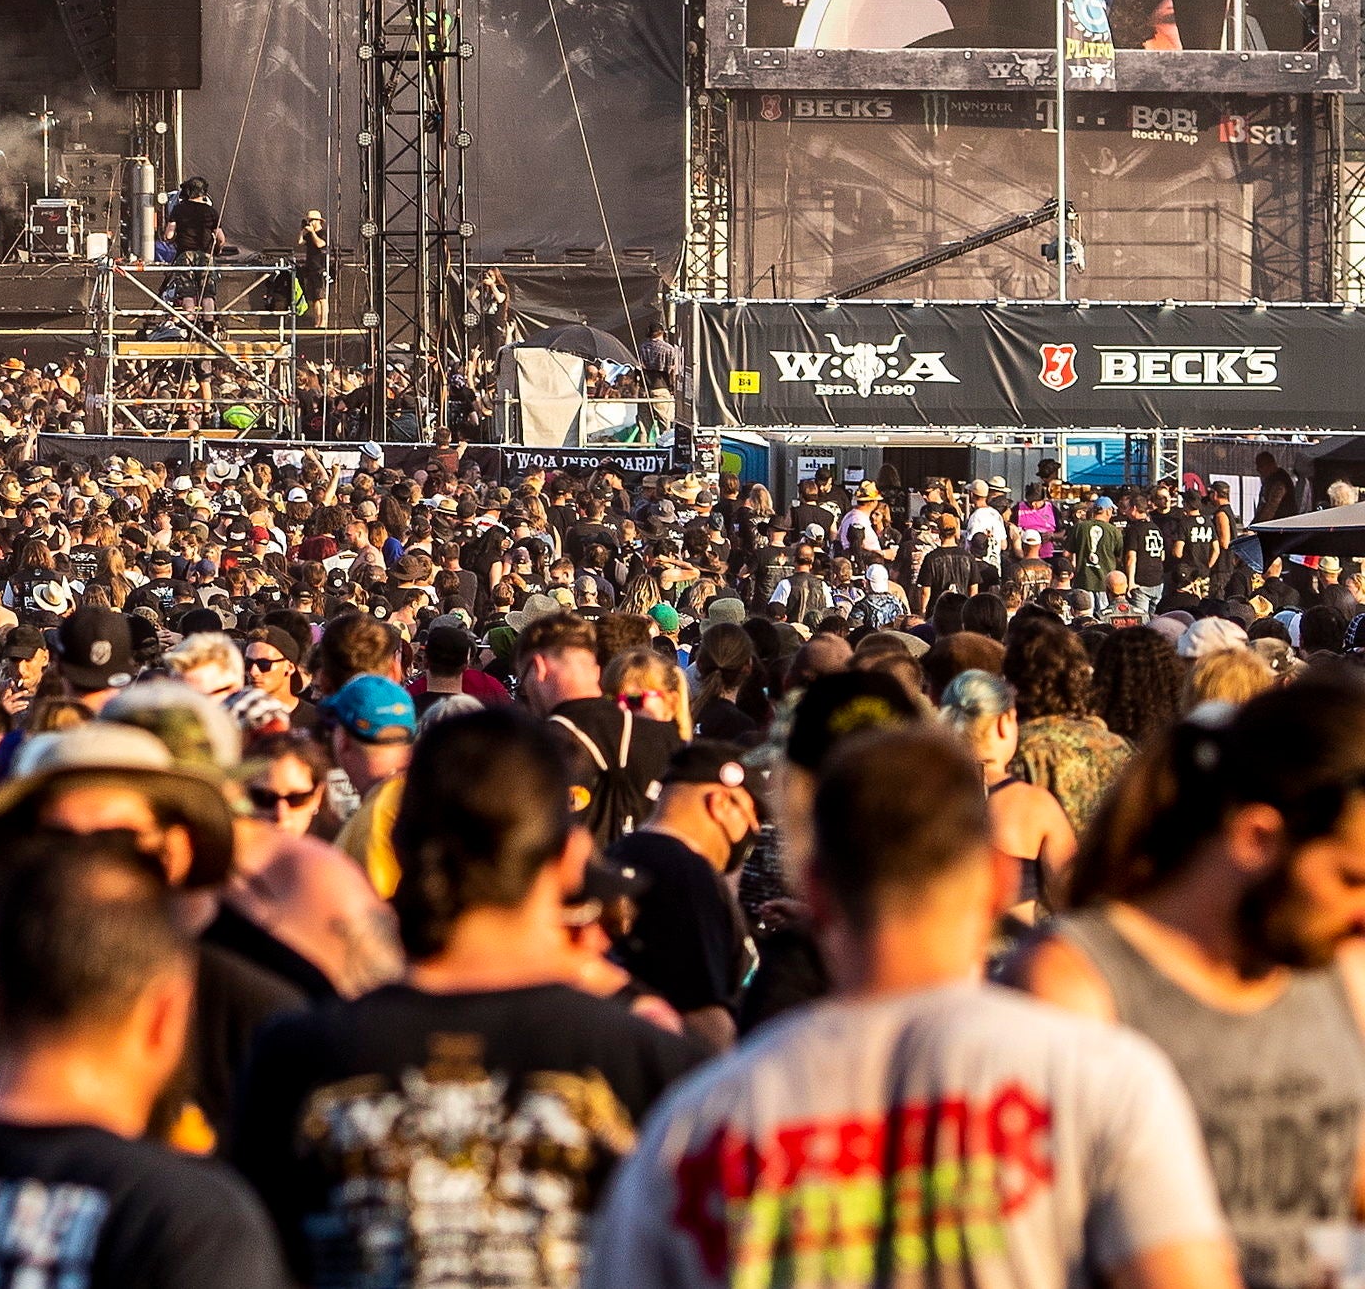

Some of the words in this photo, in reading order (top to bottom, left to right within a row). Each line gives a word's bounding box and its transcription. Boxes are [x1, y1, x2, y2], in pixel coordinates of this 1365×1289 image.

[795, 98, 893, 118] BECK'S
[1132, 106, 1198, 133] BOB!
[1132, 130, 1172, 141] Rock'n
[1175, 132, 1199, 145] Pop
[1098, 347, 1277, 385] BECK'S
[738, 378, 751, 387] B4
[814, 384, 857, 396] ESTD.
[873, 384, 916, 396] 1990
[801, 449, 833, 457] 12339
[1190, 526, 1213, 543] #44
